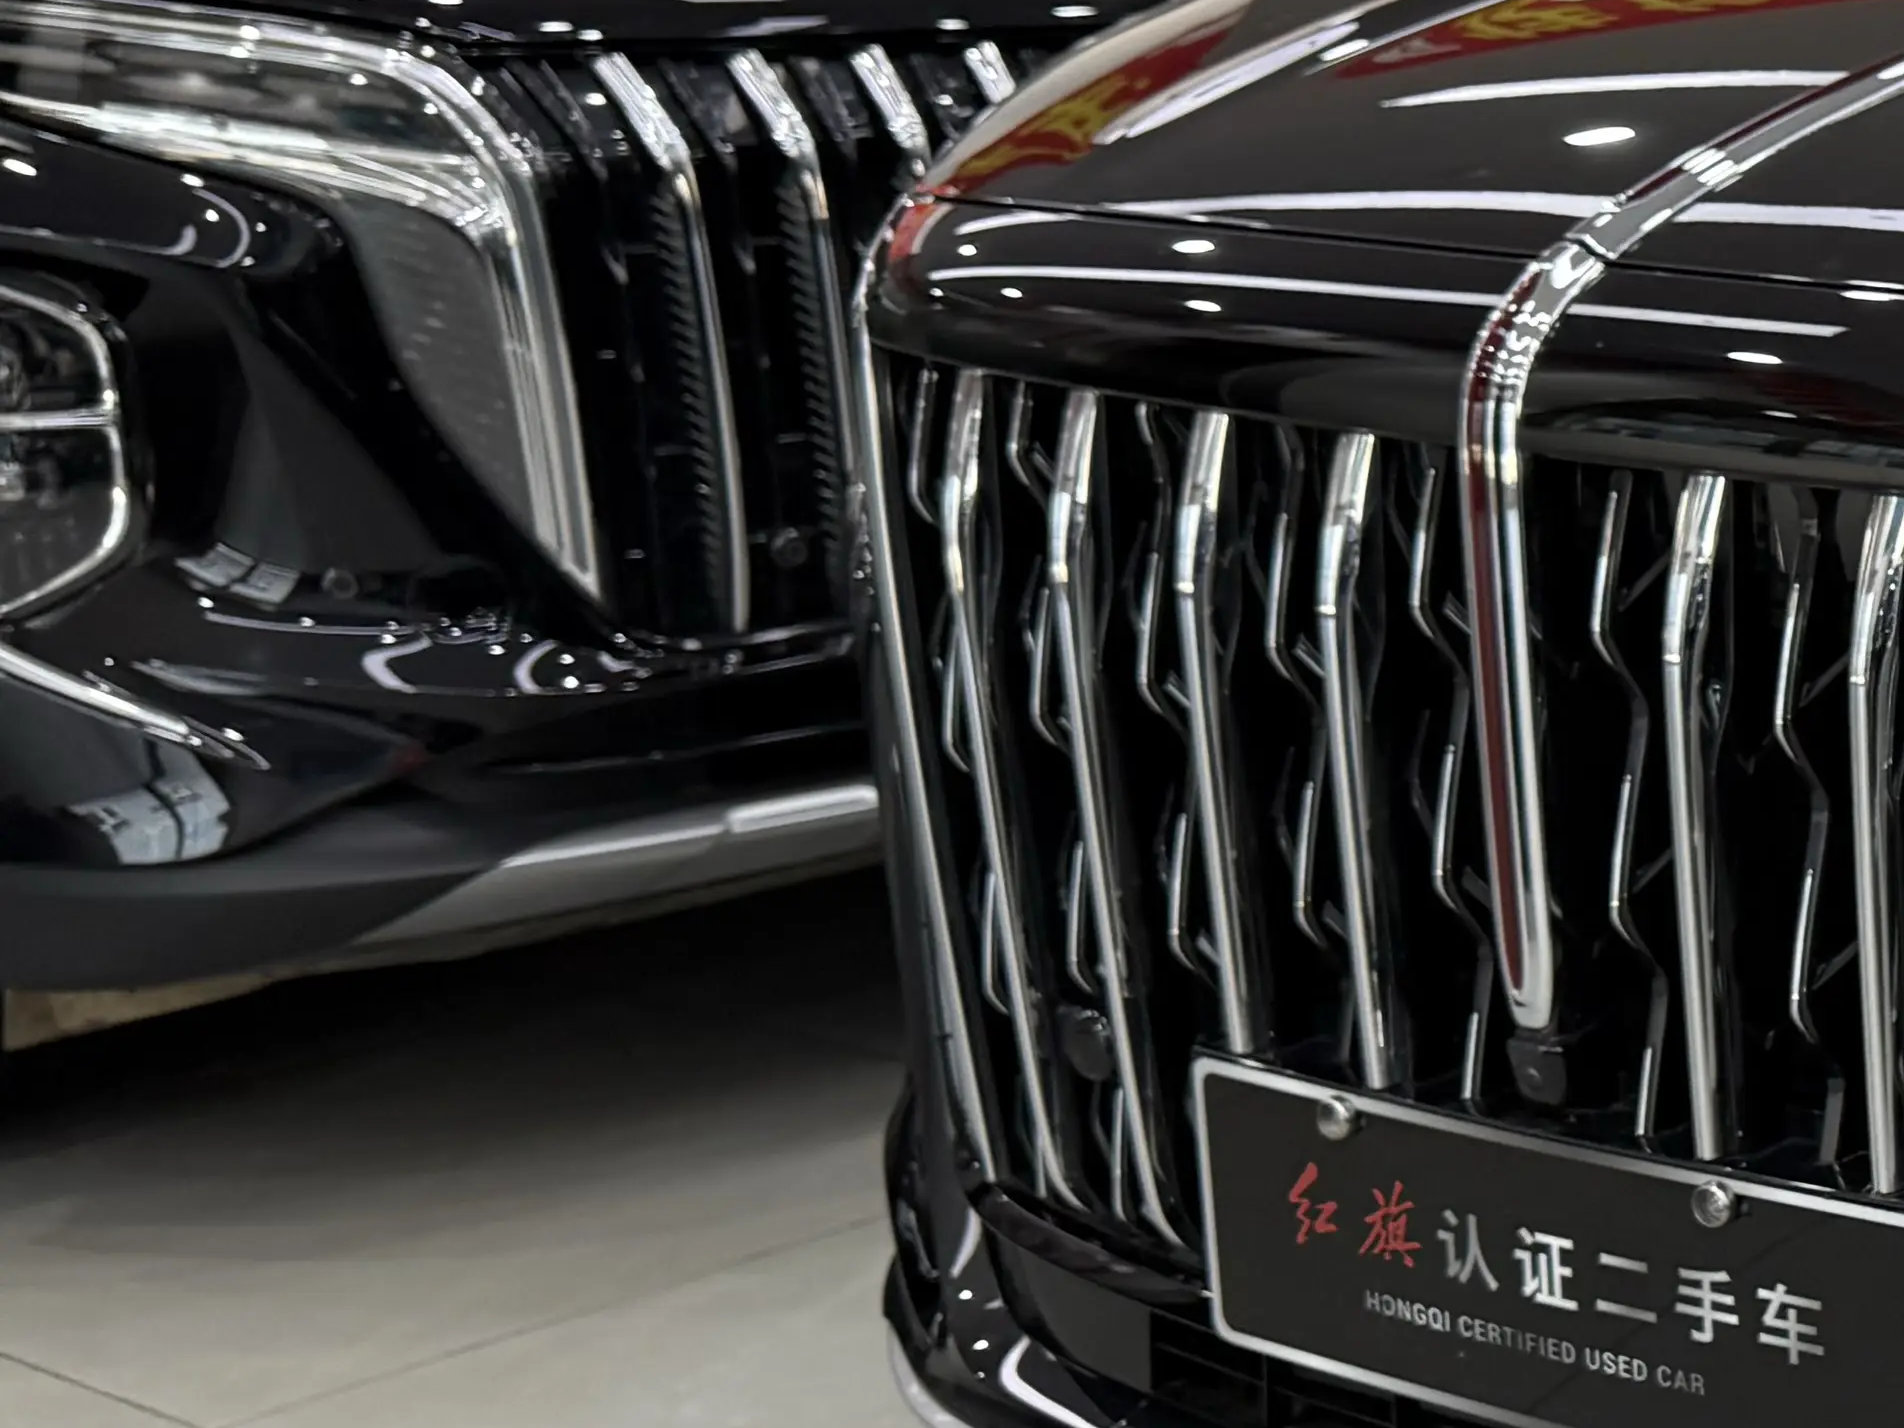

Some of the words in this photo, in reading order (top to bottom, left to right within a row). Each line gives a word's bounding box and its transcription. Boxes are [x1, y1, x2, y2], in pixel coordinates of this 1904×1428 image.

[1365, 1289, 1450, 1332] HONGQI
[1459, 1315, 1576, 1364] CERTIFIED
[1585, 1346, 1648, 1381] USED
[1656, 1364, 1705, 1396] CAR
